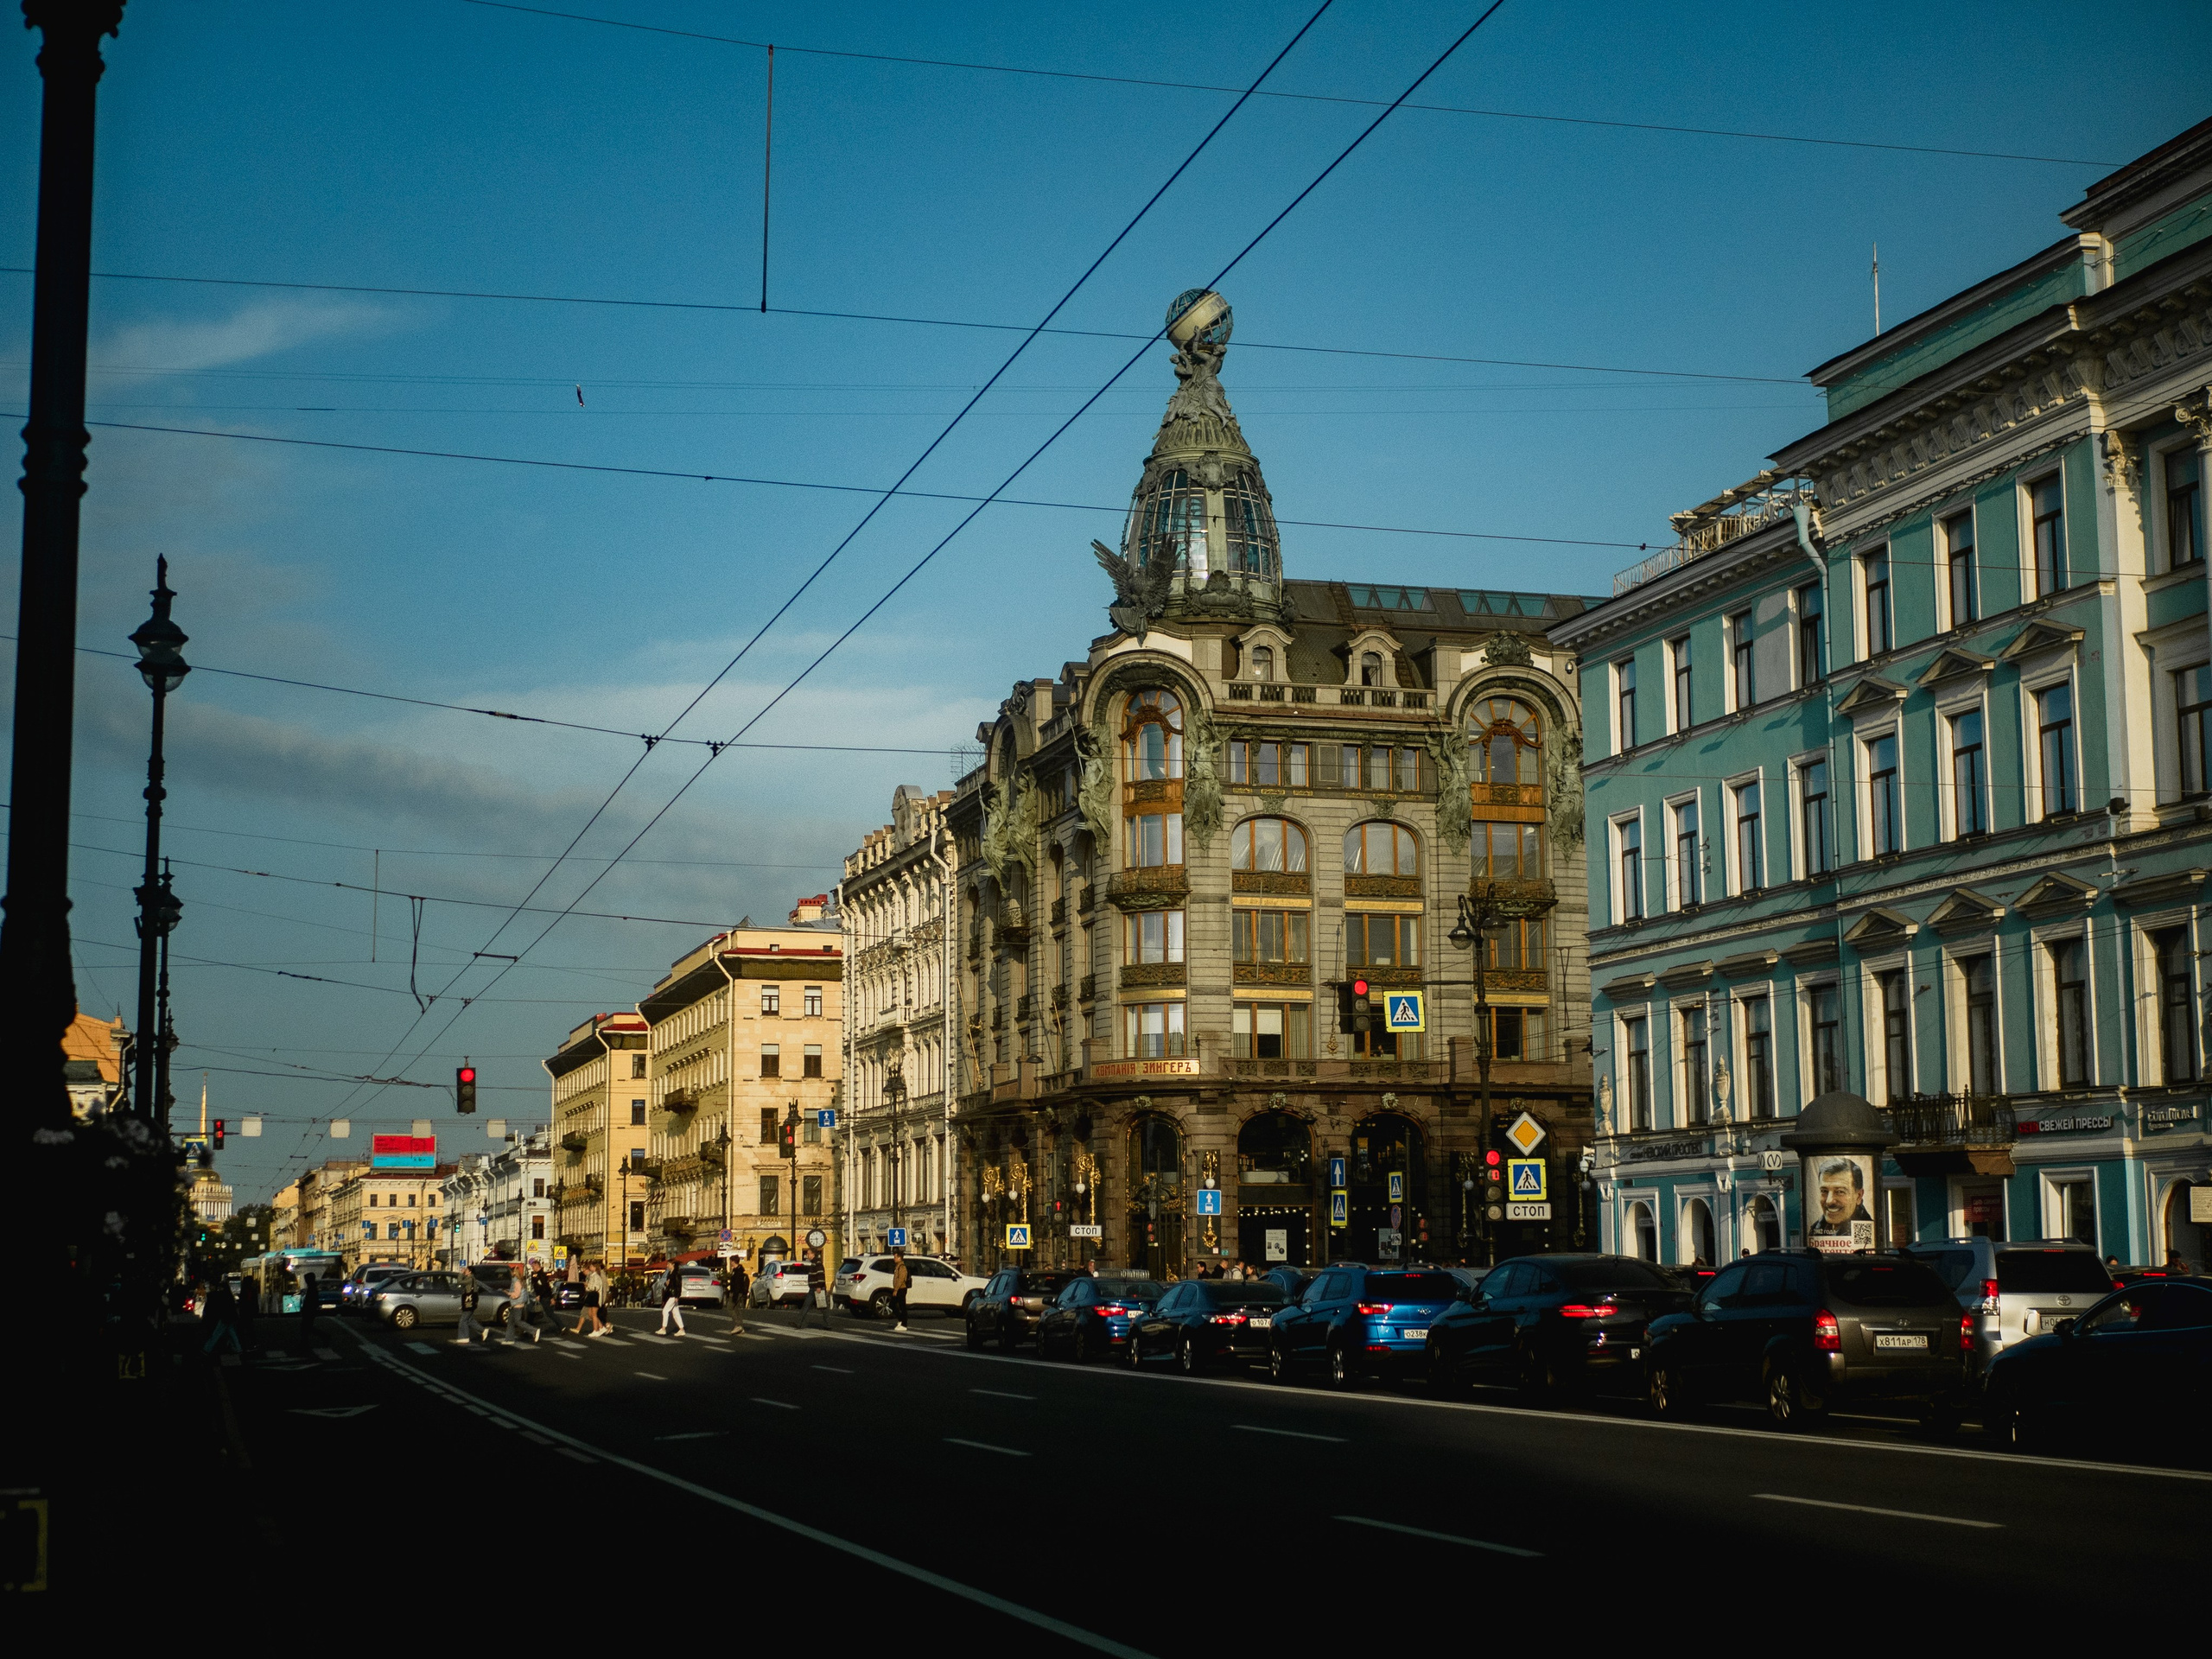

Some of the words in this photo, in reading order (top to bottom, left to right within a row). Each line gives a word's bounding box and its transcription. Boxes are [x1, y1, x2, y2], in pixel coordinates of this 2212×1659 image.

[1096, 1063, 1135, 1076] КОМПАНІЯ
[1142, 1062, 1192, 1073] ЗИНГЕРЪ
[2039, 1117, 2074, 1131] СВЕЖЕЙ
[2075, 1116, 2112, 1129] ПРЕССЫ
[1513, 1206, 1545, 1217] СТОП
[1808, 1237, 1852, 1249] Брачное
[1879, 1337, 1911, 1346] Х811АР
